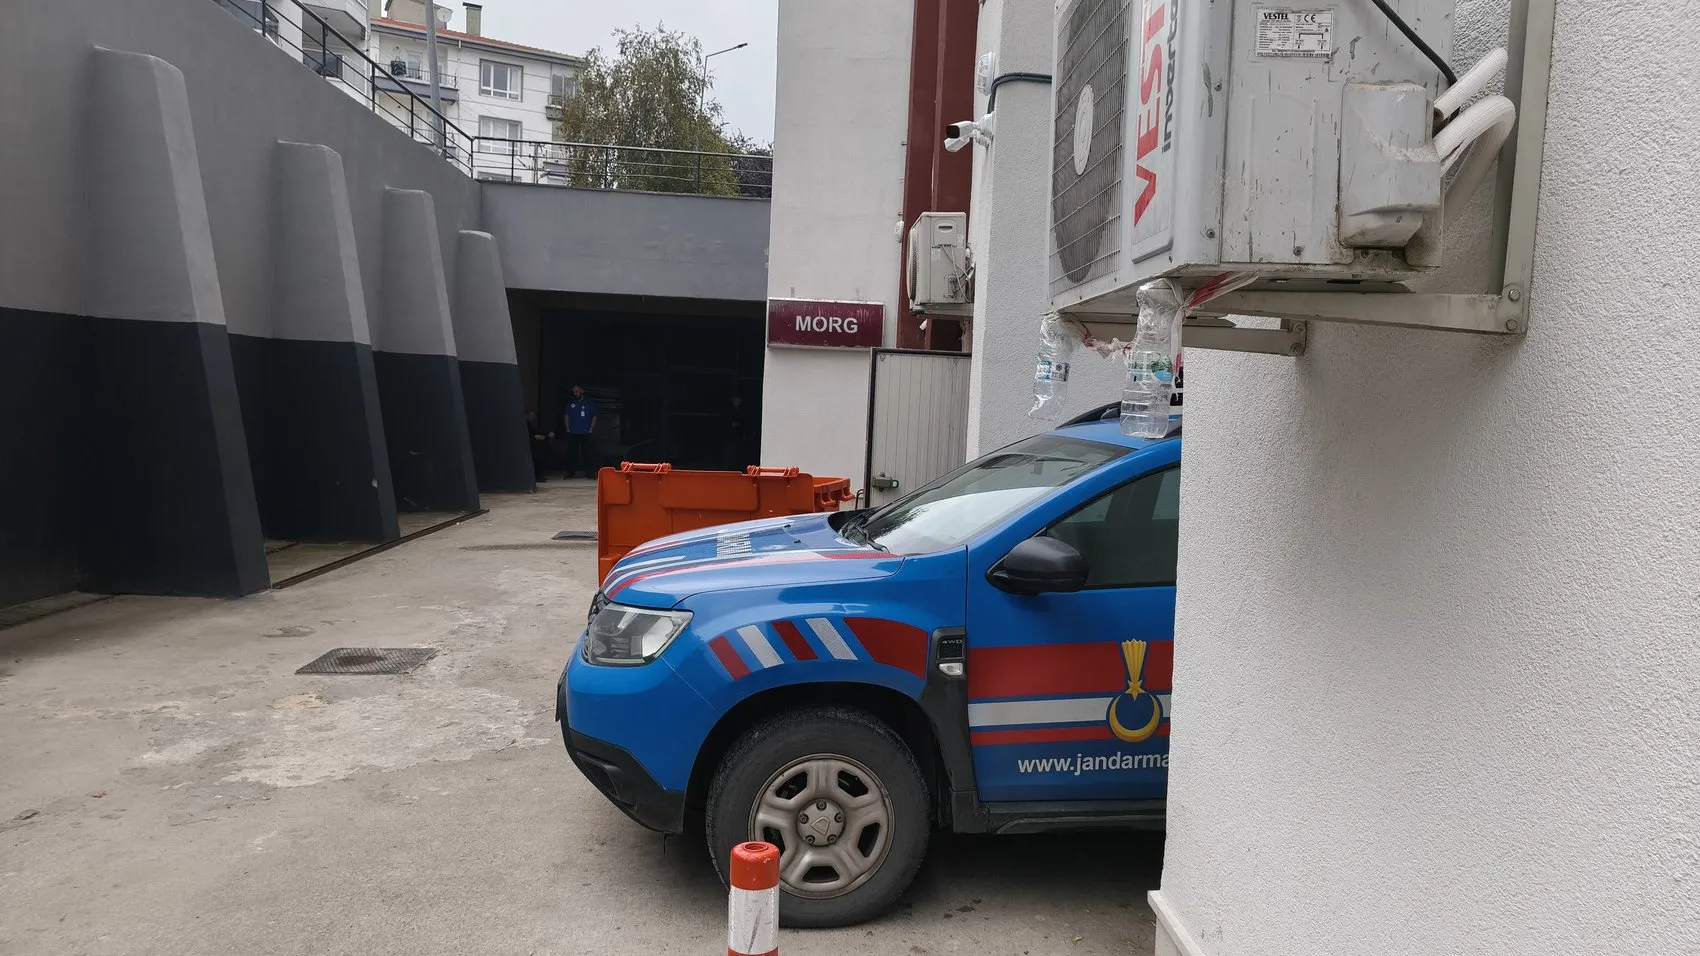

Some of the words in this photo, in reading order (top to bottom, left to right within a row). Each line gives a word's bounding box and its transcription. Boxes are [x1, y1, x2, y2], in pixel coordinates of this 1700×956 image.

[1263, 12, 1289, 20] VESTEL
[1133, 0, 1165, 229] VEST
[795, 315, 858, 333] MORG
[1017, 751, 1169, 776] www.jandarma
